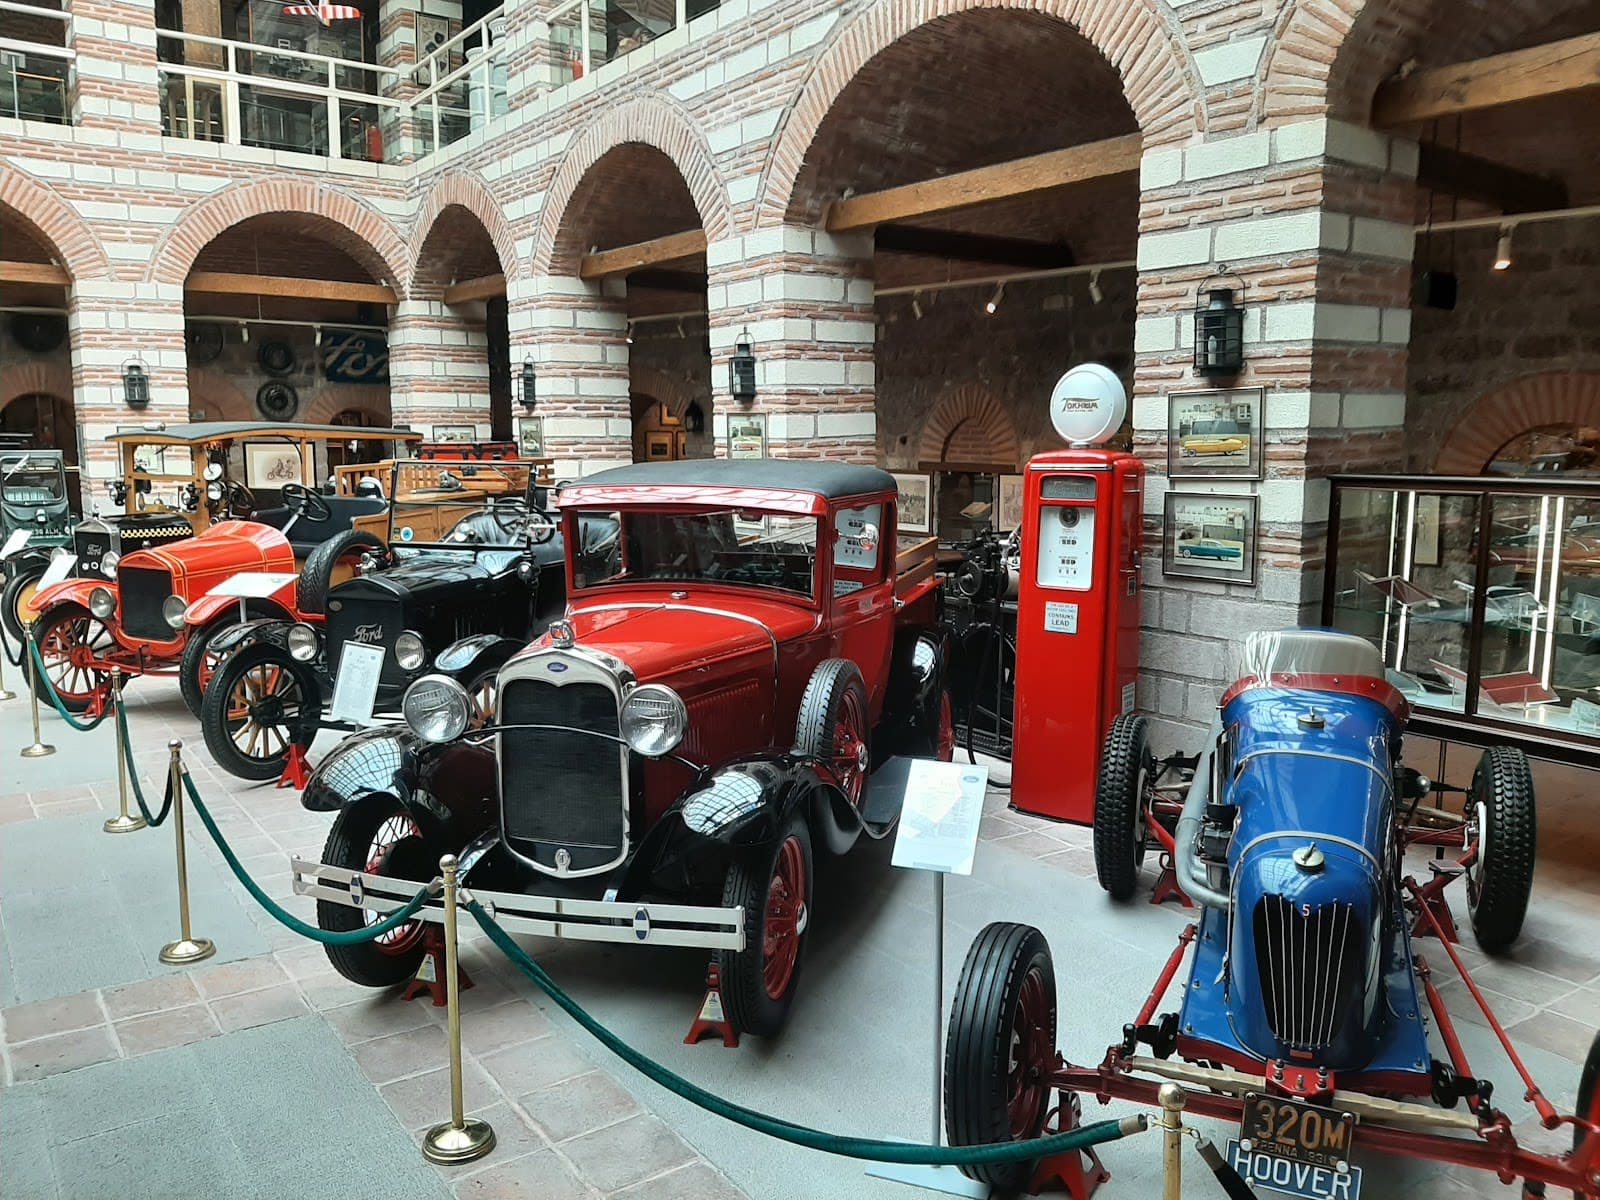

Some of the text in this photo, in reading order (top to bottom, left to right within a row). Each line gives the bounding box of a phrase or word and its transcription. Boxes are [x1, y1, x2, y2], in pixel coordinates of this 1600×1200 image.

[353, 623, 383, 641] Ford
[1051, 619, 1070, 627] LEAD
[1302, 903, 1311, 917] 5
[1255, 1099, 1345, 1150] 320M
[1260, 1140, 1298, 1158] PENNA
[1234, 1147, 1352, 1200] HOOVER
